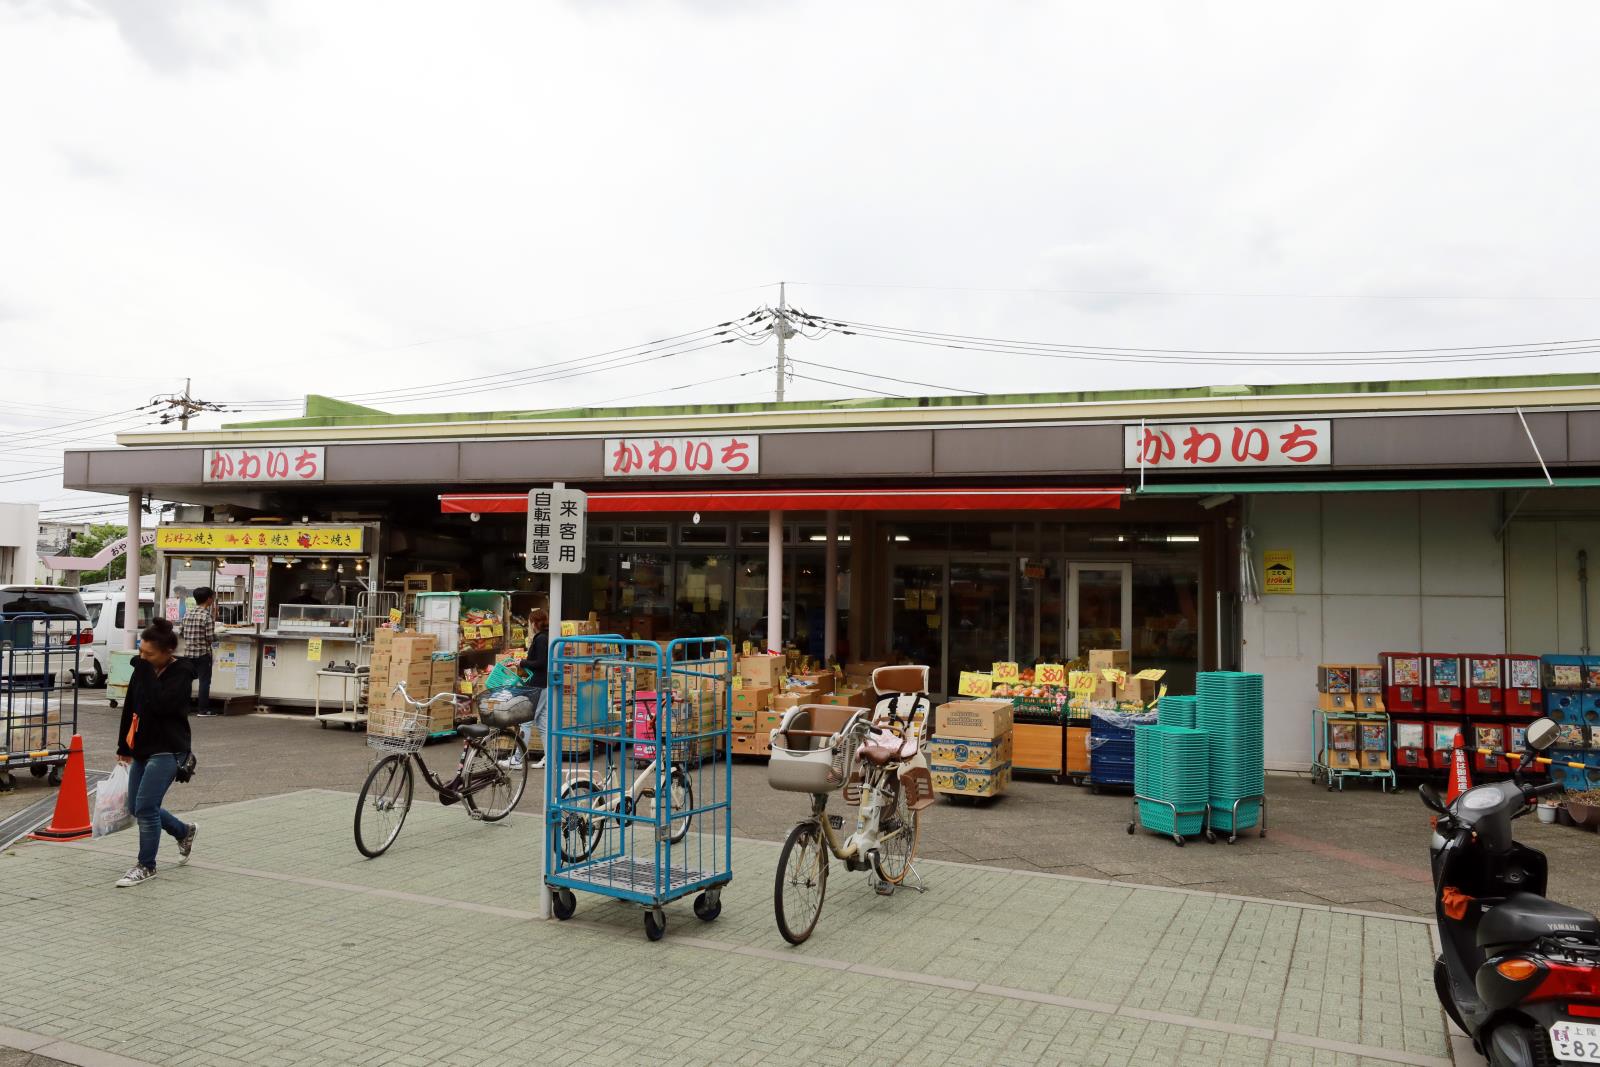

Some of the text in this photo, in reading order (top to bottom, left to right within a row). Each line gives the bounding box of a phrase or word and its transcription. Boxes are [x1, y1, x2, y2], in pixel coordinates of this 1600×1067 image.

[613, 438, 750, 473] かわいち
[1136, 424, 1318, 465] かわいち
[210, 449, 317, 480] かわいち
[164, 532, 352, 547] お好み焼き 金魚焼き たこ焼き
[531, 491, 551, 570] 自転車置場
[558, 500, 578, 563] 来客用
[1547, 923, 1581, 931] YAMAHA
[1573, 1040, 1600, 1059] 82
